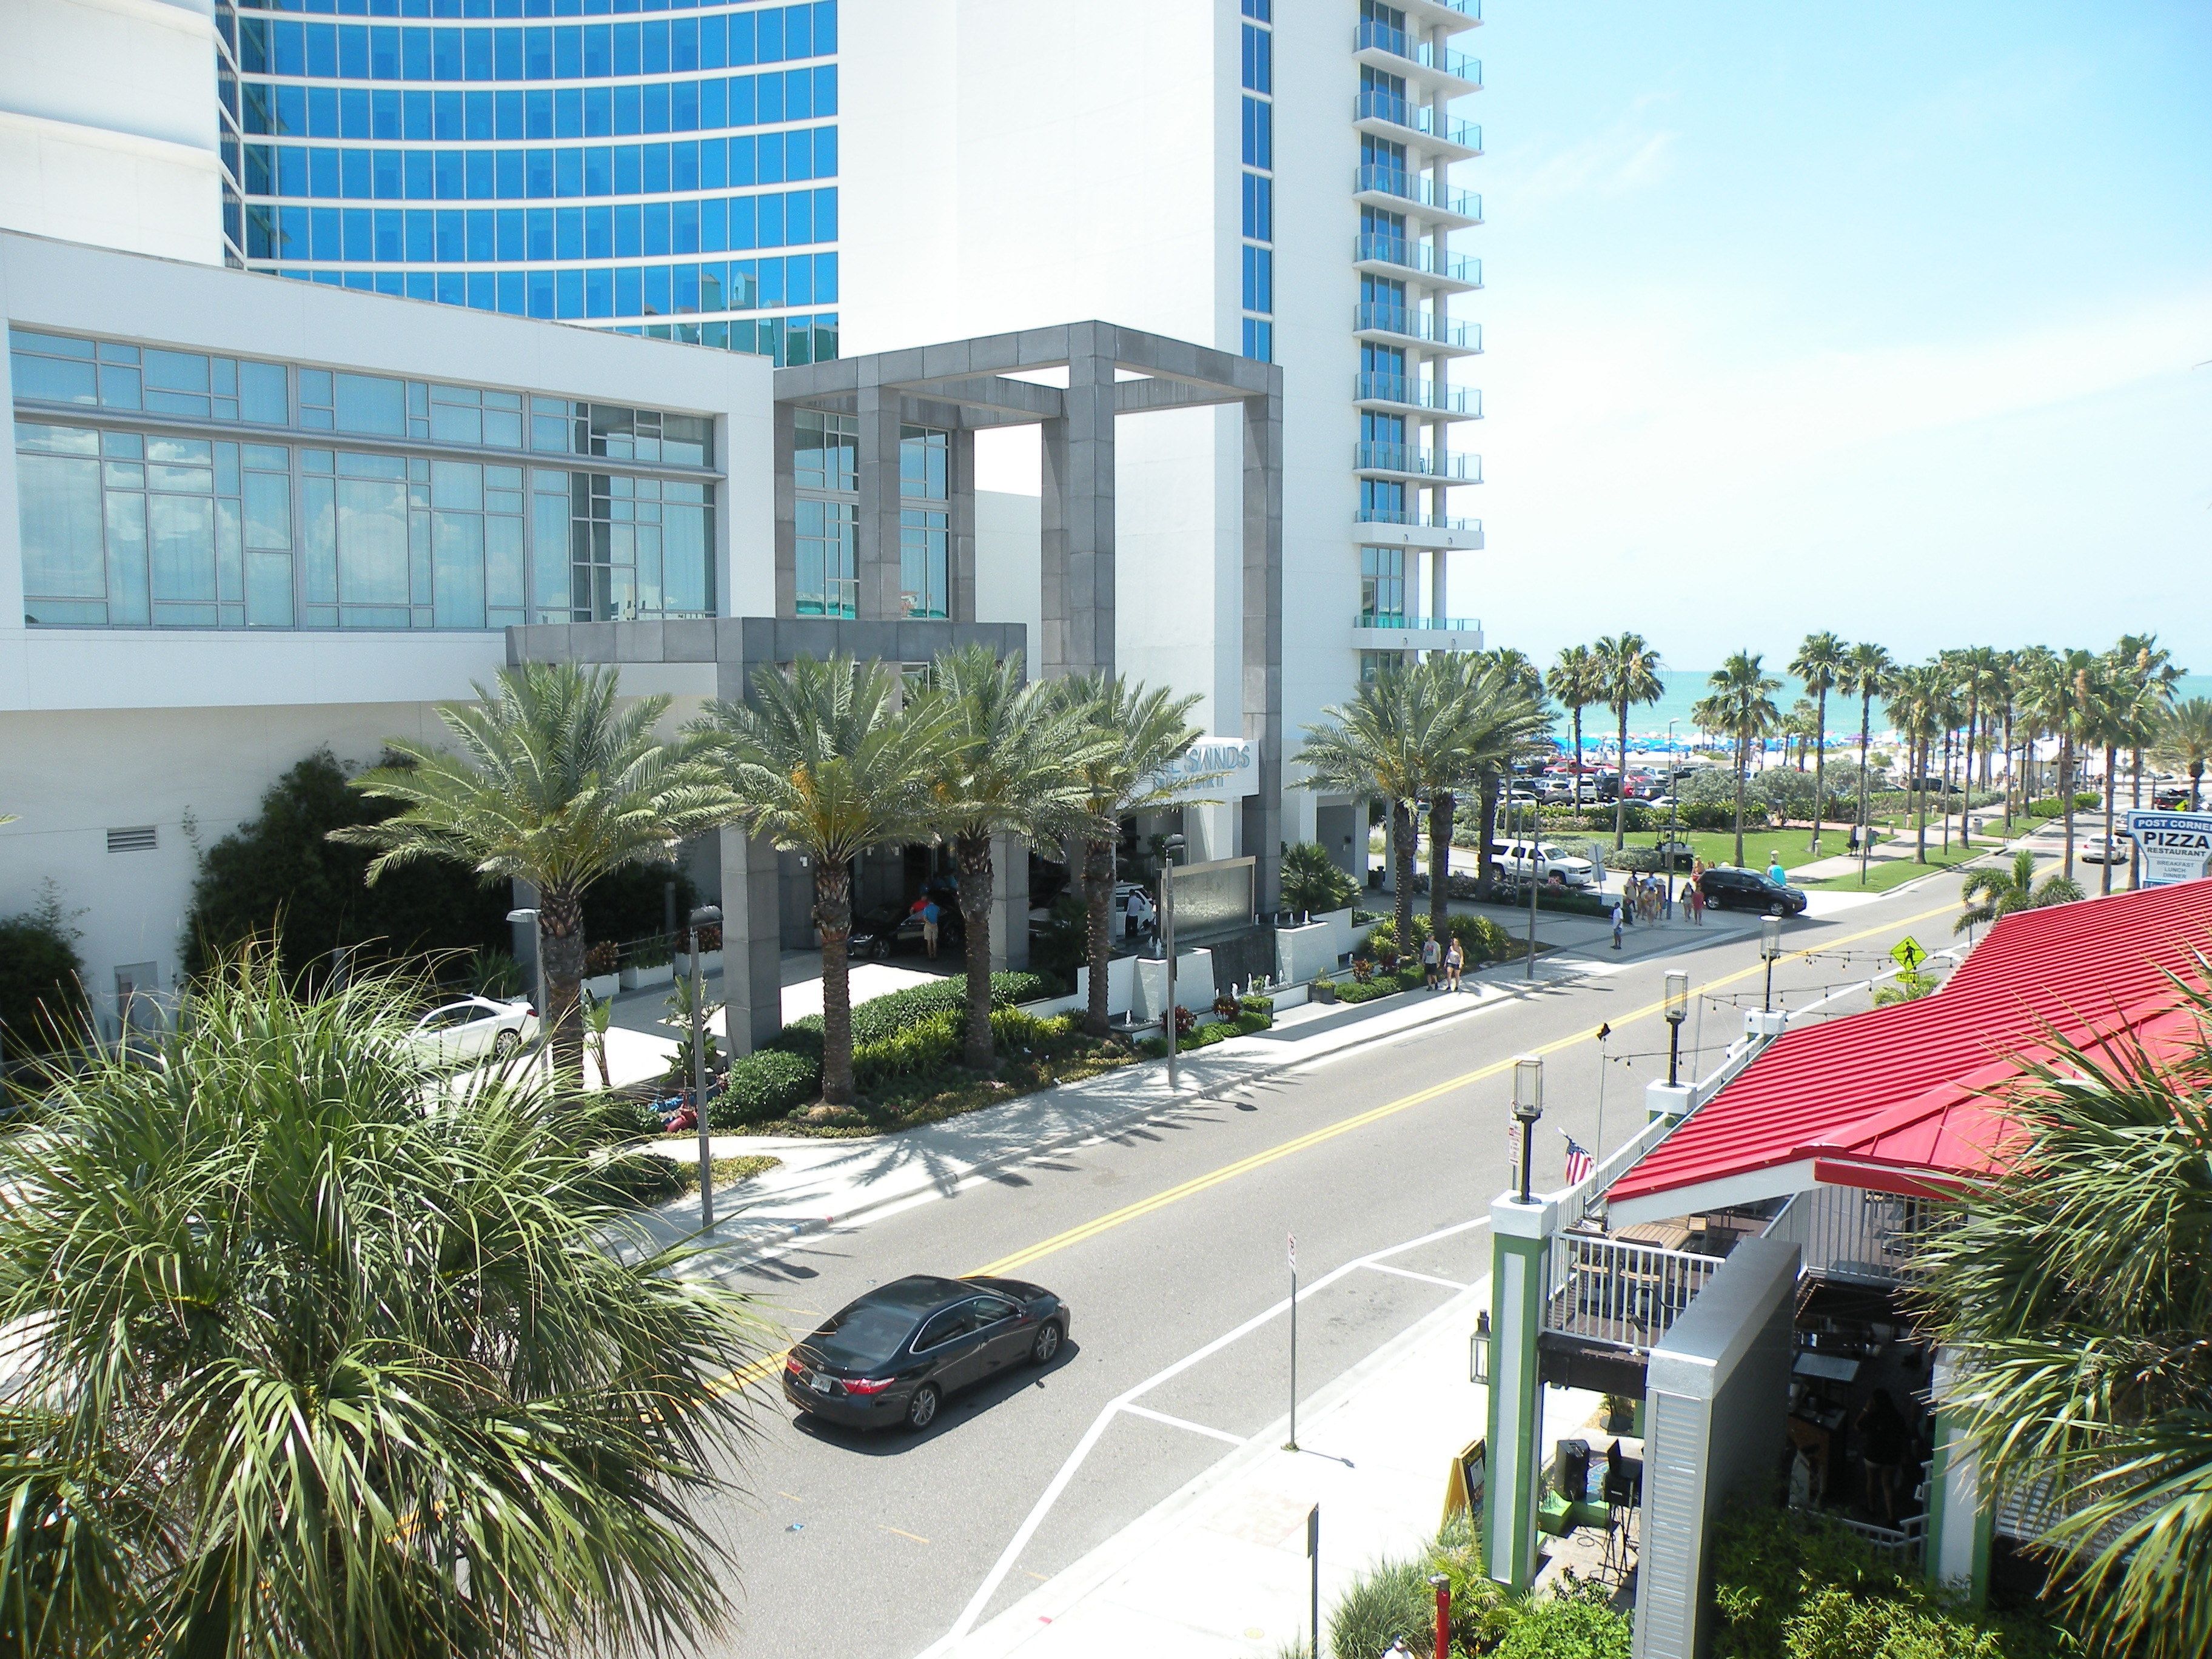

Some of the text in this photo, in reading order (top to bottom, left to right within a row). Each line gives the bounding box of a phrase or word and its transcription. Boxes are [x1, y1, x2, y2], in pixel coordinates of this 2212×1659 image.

[1184, 745, 1250, 773] SANDS
[2143, 831, 2210, 850] PIZZA
[2147, 847, 2206, 857] RESTAURANT
